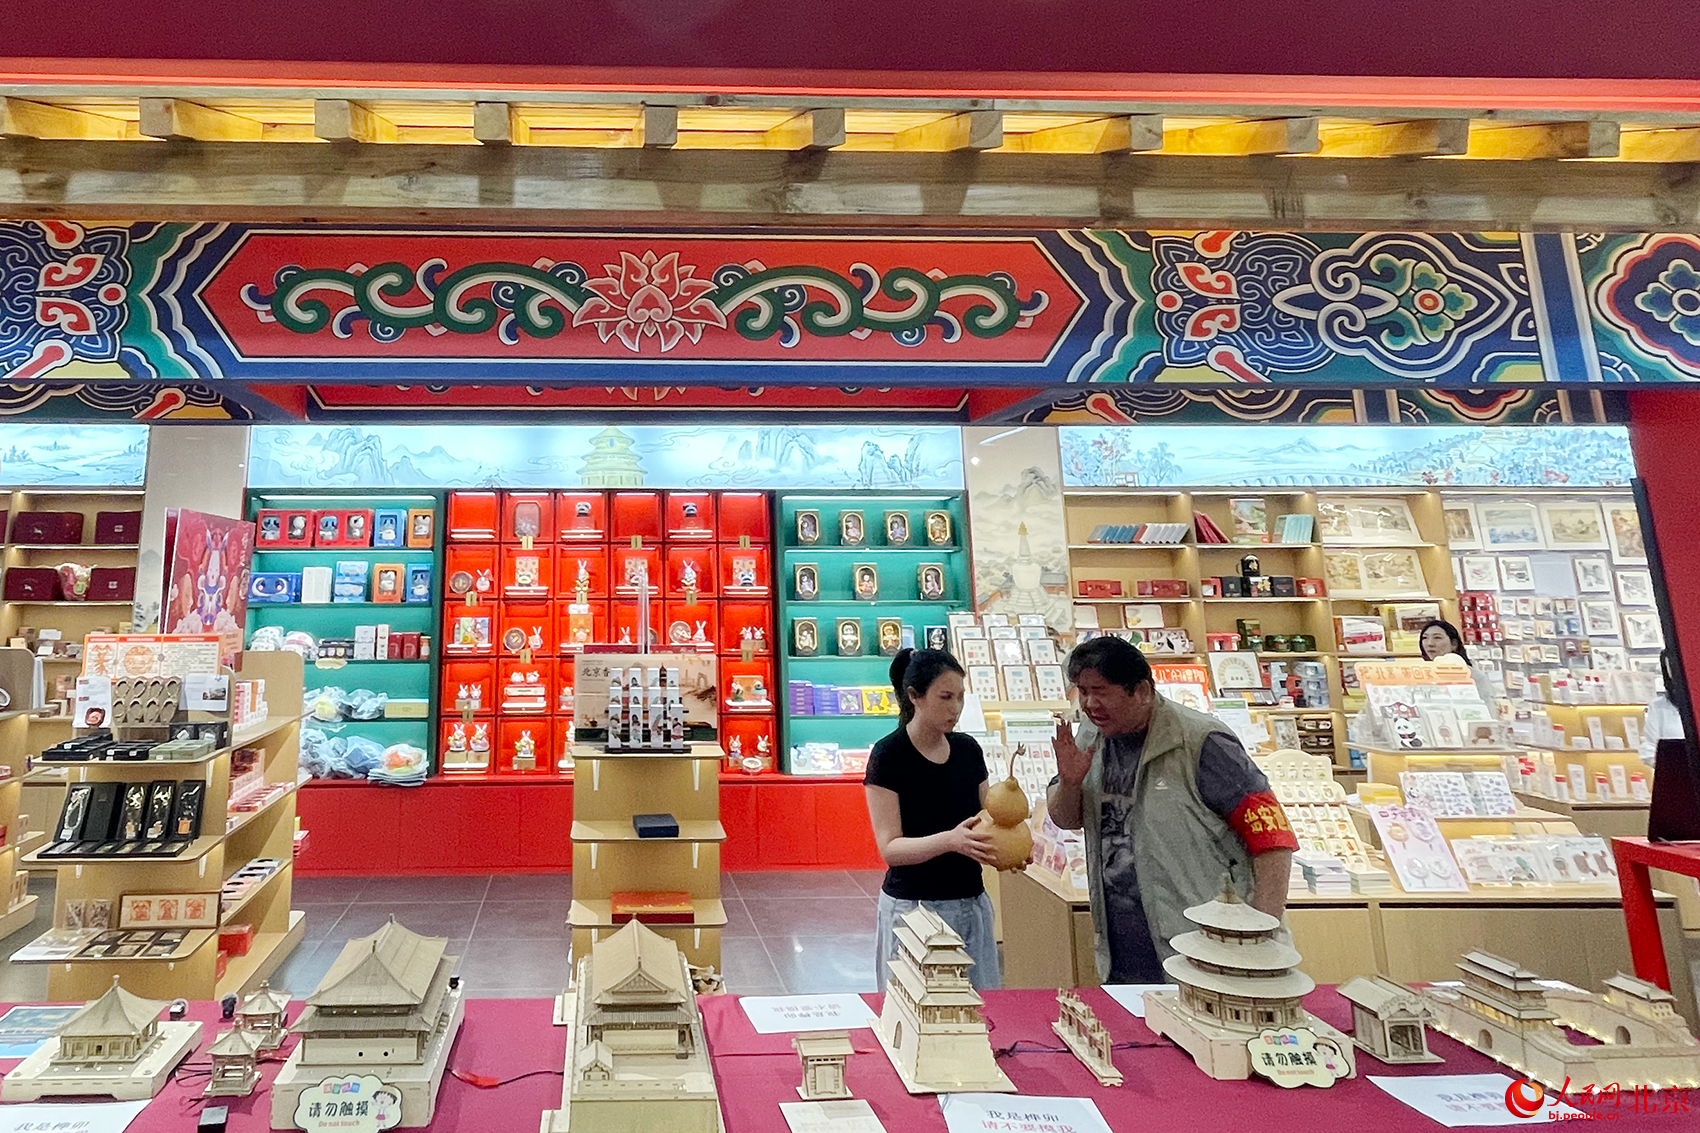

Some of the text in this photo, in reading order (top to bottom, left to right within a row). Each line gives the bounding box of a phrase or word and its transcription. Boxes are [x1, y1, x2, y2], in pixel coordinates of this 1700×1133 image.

[1261, 1051, 1317, 1066] 请勿触摸
[308, 1100, 369, 1118] 请勿触摸
[986, 1110, 1059, 1122] 我是榫卯
